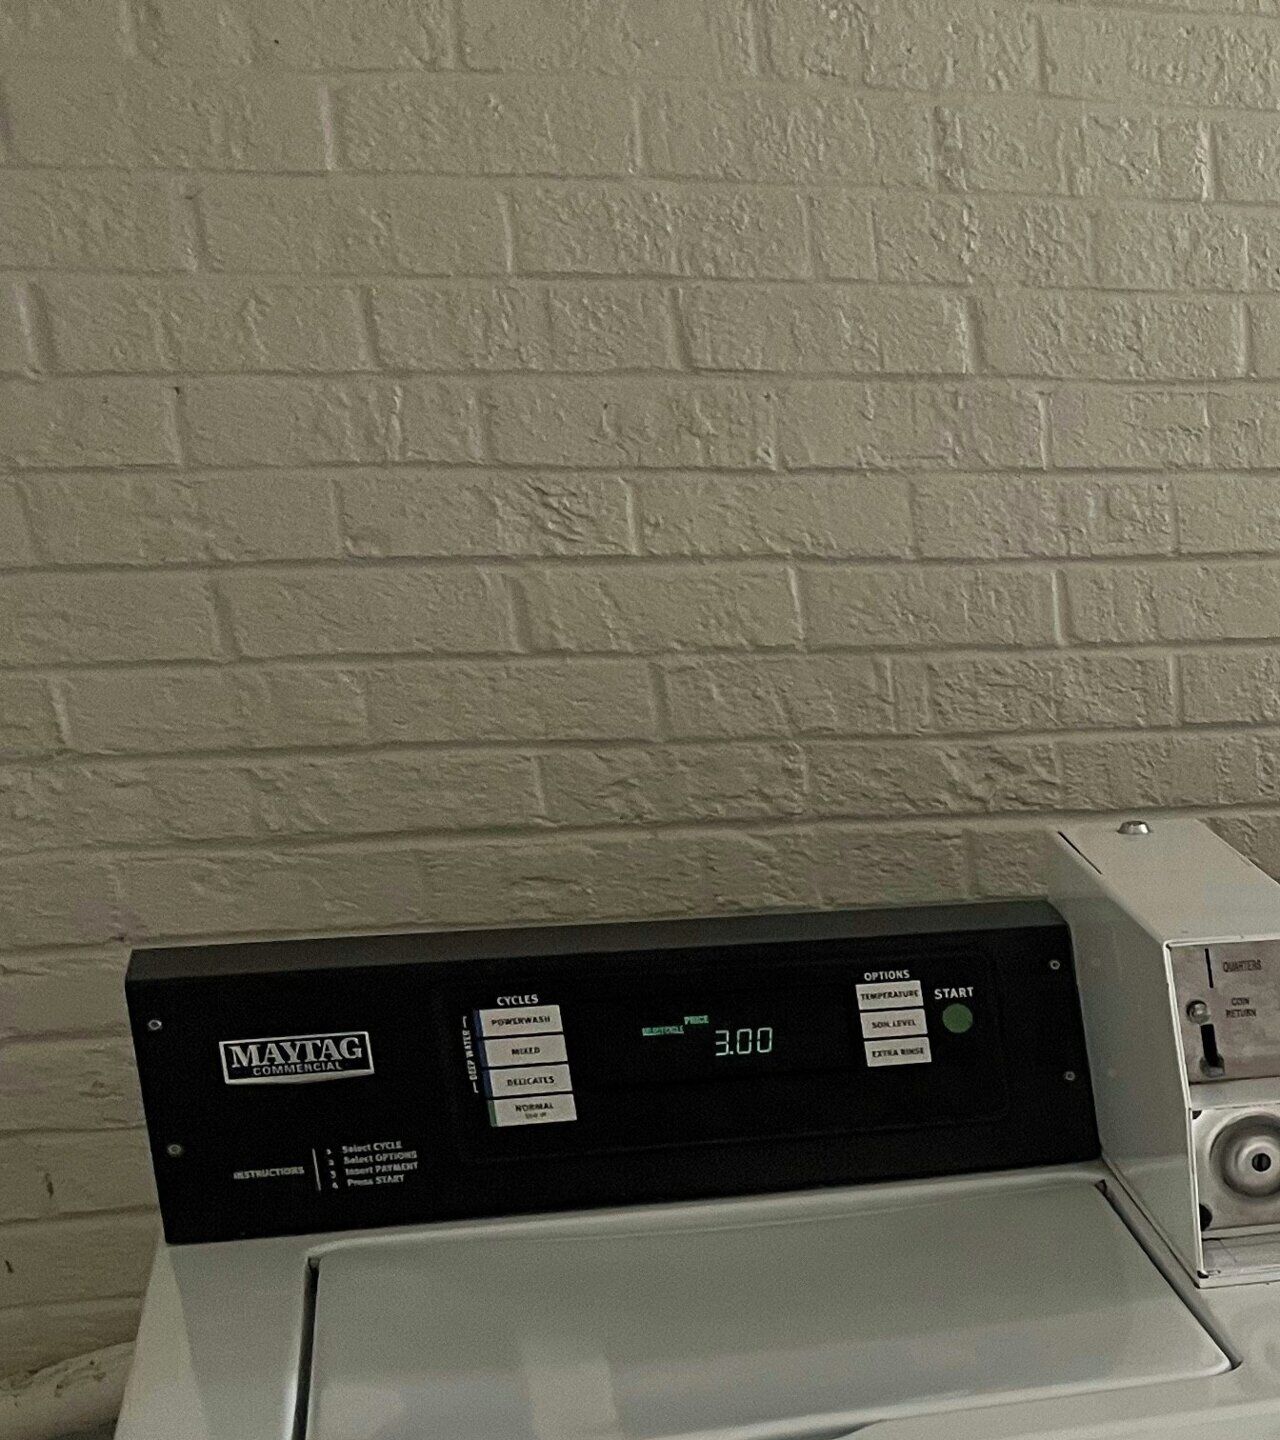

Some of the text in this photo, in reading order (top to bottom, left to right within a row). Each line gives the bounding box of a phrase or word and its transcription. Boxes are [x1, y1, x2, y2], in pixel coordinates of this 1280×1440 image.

[864, 969, 910, 981] OPTIONS
[860, 990, 919, 1000] TEMPERATURE
[934, 986, 974, 1000] START
[497, 994, 539, 1006] CYCLES
[491, 1016, 551, 1026] POWERWASH
[892, 1019, 916, 1028] LEVEL
[716, 1027, 773, 1056] 3.00
[228, 1037, 363, 1068] MAYTAG
[462, 1030, 478, 1080] DEEP WATER
[512, 1047, 541, 1056] MIXED
[872, 1048, 899, 1058] EXTRA
[252, 1062, 343, 1076] COMMERCIAL
[507, 1076, 555, 1086] DELICATES
[515, 1102, 554, 1112] NORMAL
[373, 1141, 402, 1150] CYCLE
[376, 1151, 417, 1162] OPTIONS
[376, 1162, 418, 1173] PAYMENT
[376, 1174, 405, 1185] START
